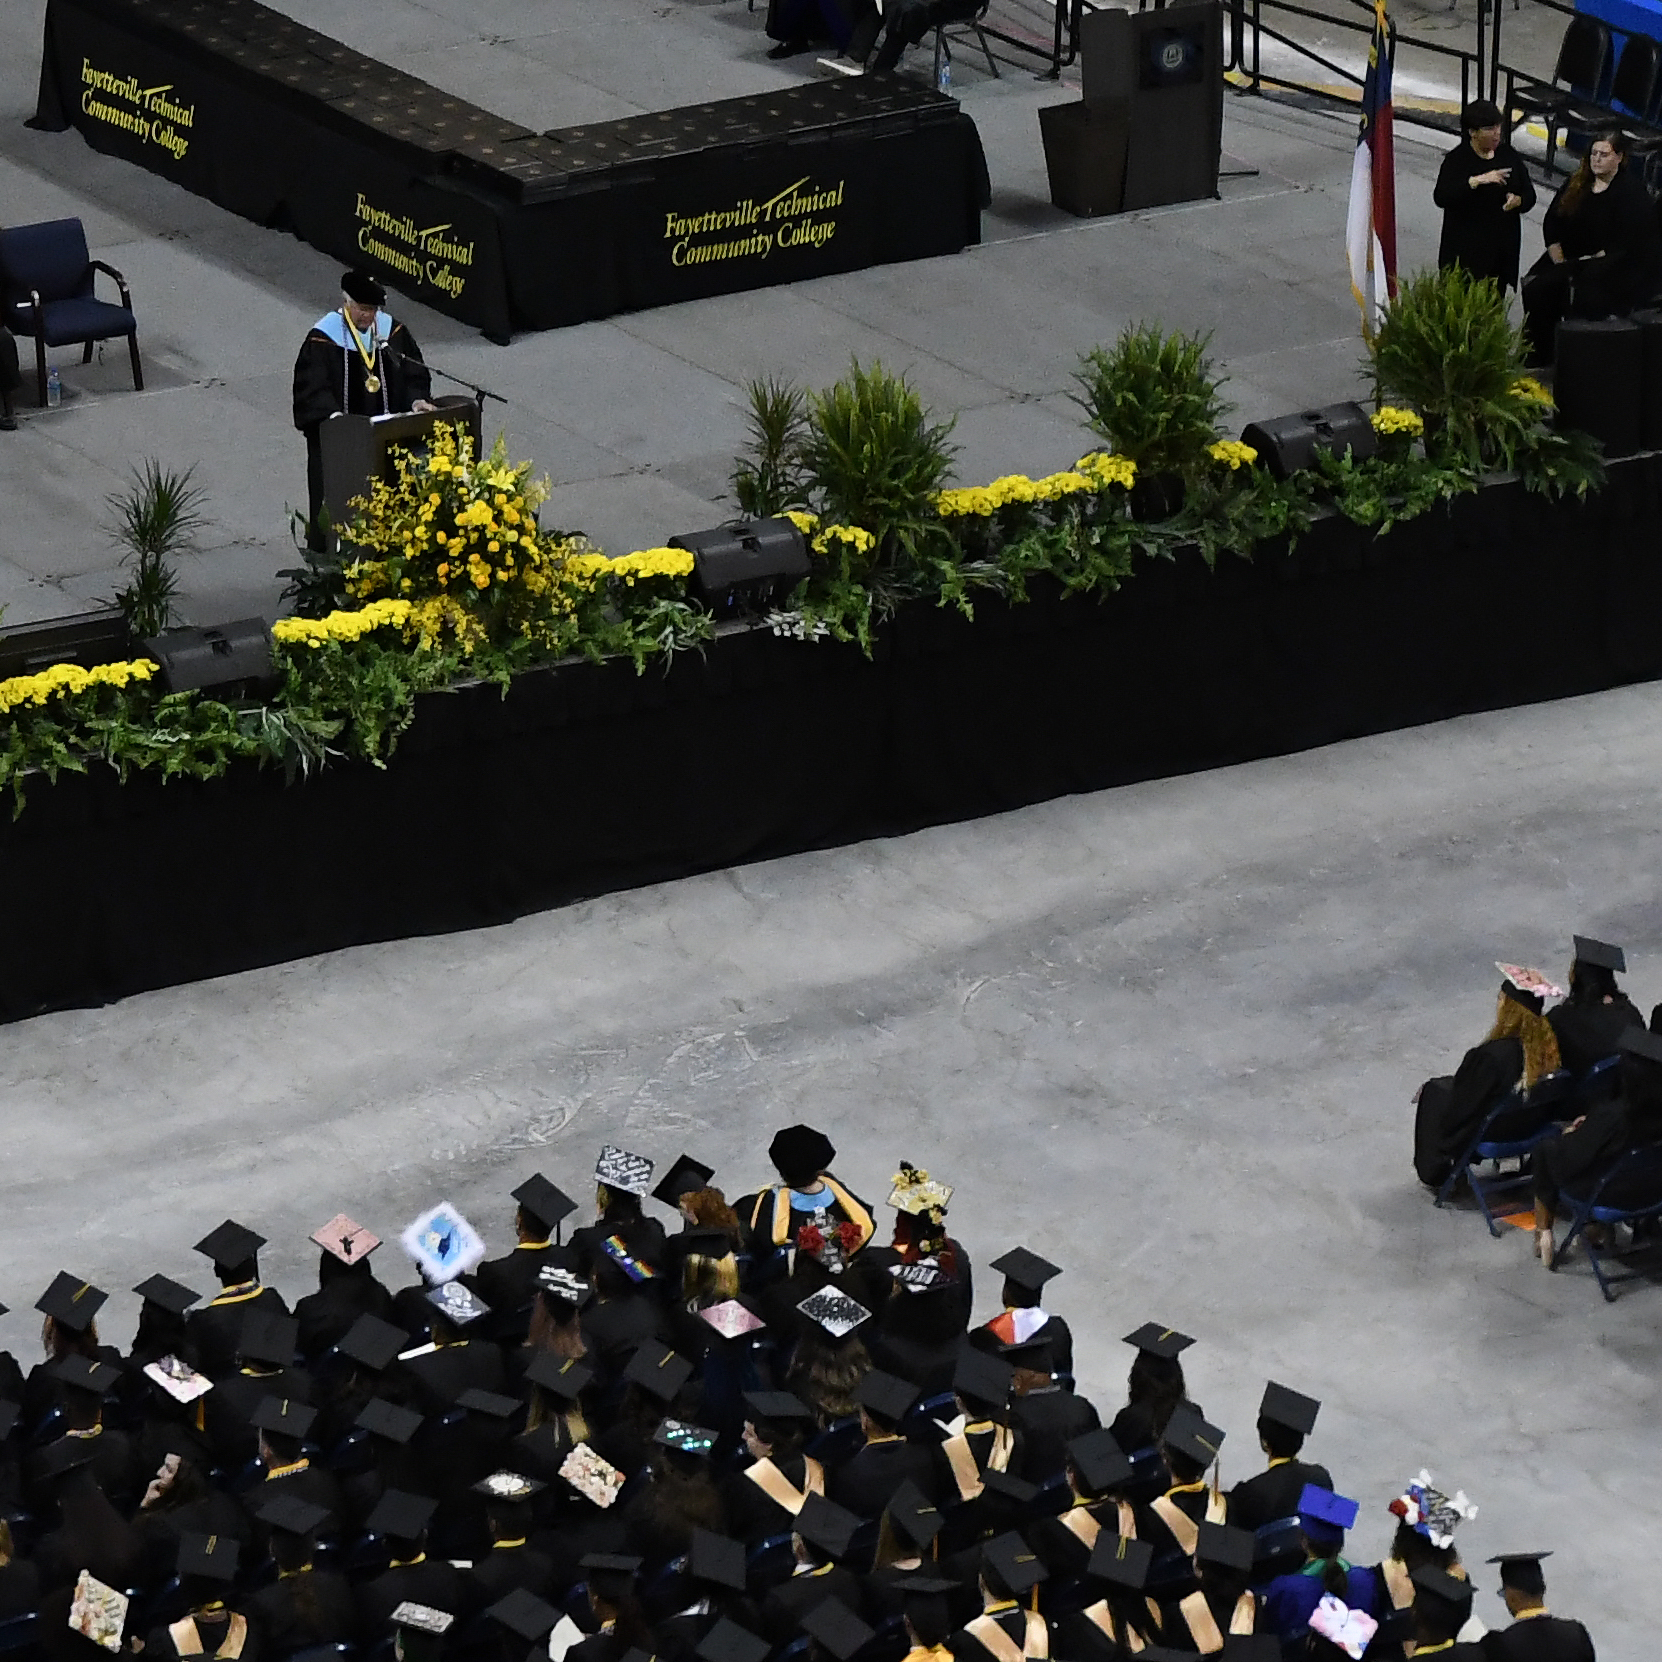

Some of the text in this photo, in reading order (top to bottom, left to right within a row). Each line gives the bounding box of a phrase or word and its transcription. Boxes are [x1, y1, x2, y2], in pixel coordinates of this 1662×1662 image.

[81, 57, 195, 128] Fayetteville Technical
[81, 90, 189, 160] Community College
[355, 192, 474, 265] Fayetteville Technical
[664, 175, 844, 242] Fayetteville Technical
[671, 218, 836, 267] Community College
[358, 226, 465, 299] Community College
